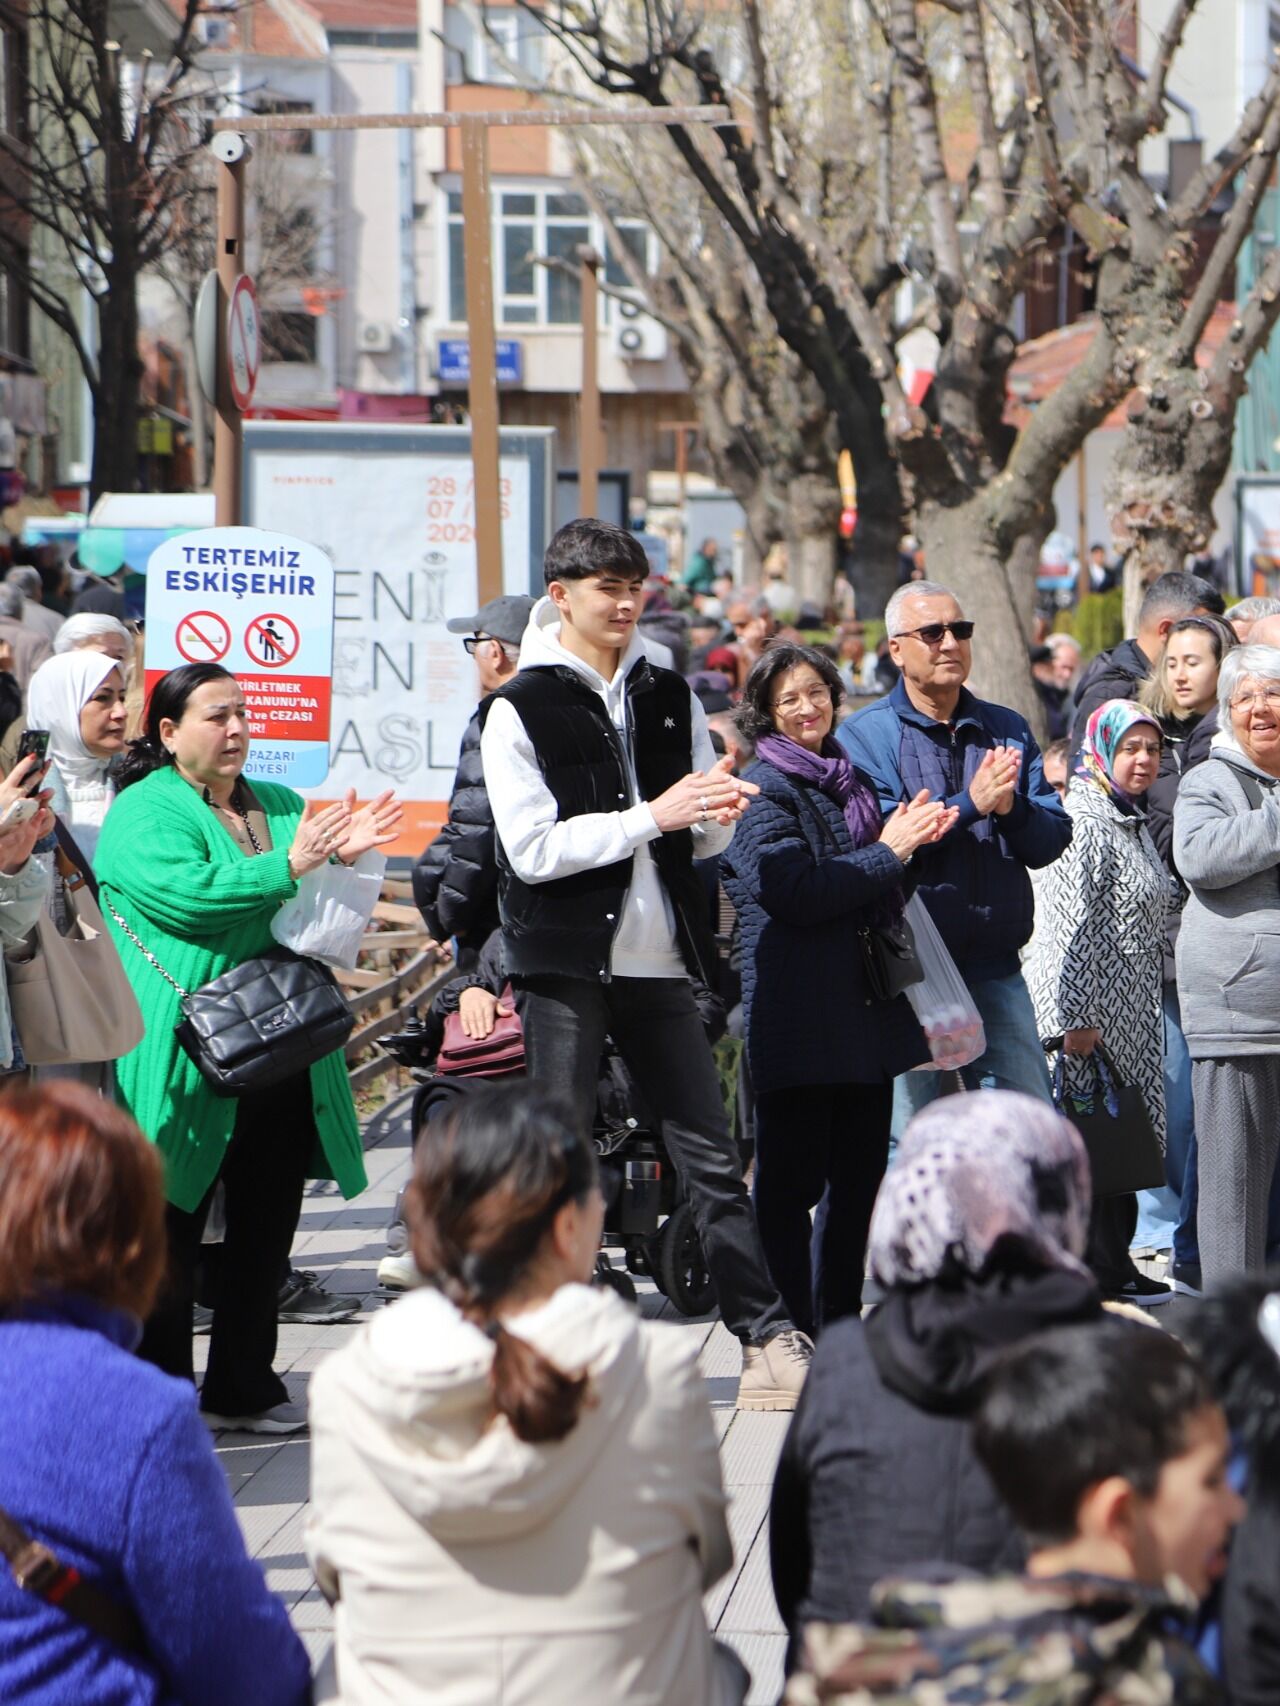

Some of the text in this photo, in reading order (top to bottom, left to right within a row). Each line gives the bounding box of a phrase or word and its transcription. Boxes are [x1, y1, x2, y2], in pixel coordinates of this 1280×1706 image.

[427, 477, 457, 497] 28
[427, 500, 453, 519] 07
[427, 523, 475, 543] 202
[182, 546, 301, 569] TERTEMİZ
[165, 567, 316, 600] ESKİŞEHİR
[333, 552, 447, 623] ENİ
[333, 638, 414, 700] EN
[254, 712, 267, 720] ve
[269, 710, 313, 722] CEZASI
[248, 722, 266, 734] IR!
[249, 750, 296, 761] PAZARI
[329, 712, 457, 785] AŞL
